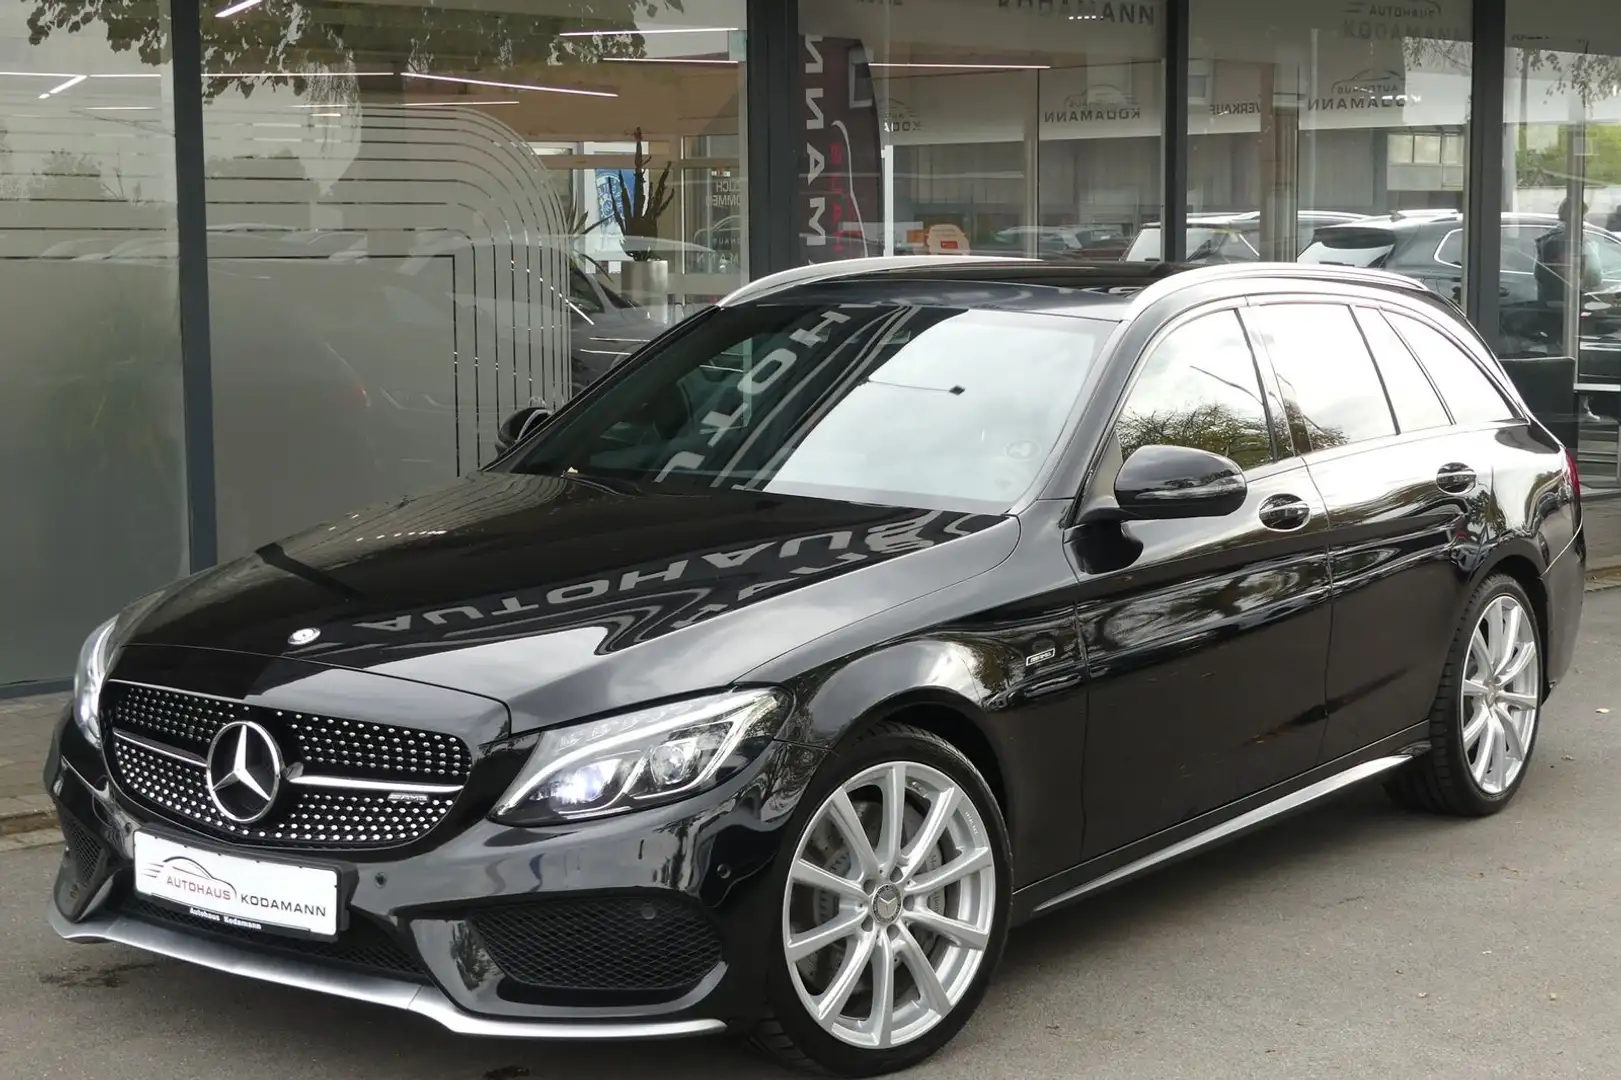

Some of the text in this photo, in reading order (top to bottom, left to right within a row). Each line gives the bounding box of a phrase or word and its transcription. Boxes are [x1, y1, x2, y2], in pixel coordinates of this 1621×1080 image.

[166, 875, 326, 917] AUTOHAUS KODAMANN
[189, 906, 262, 931] Autohaus Kodamann
